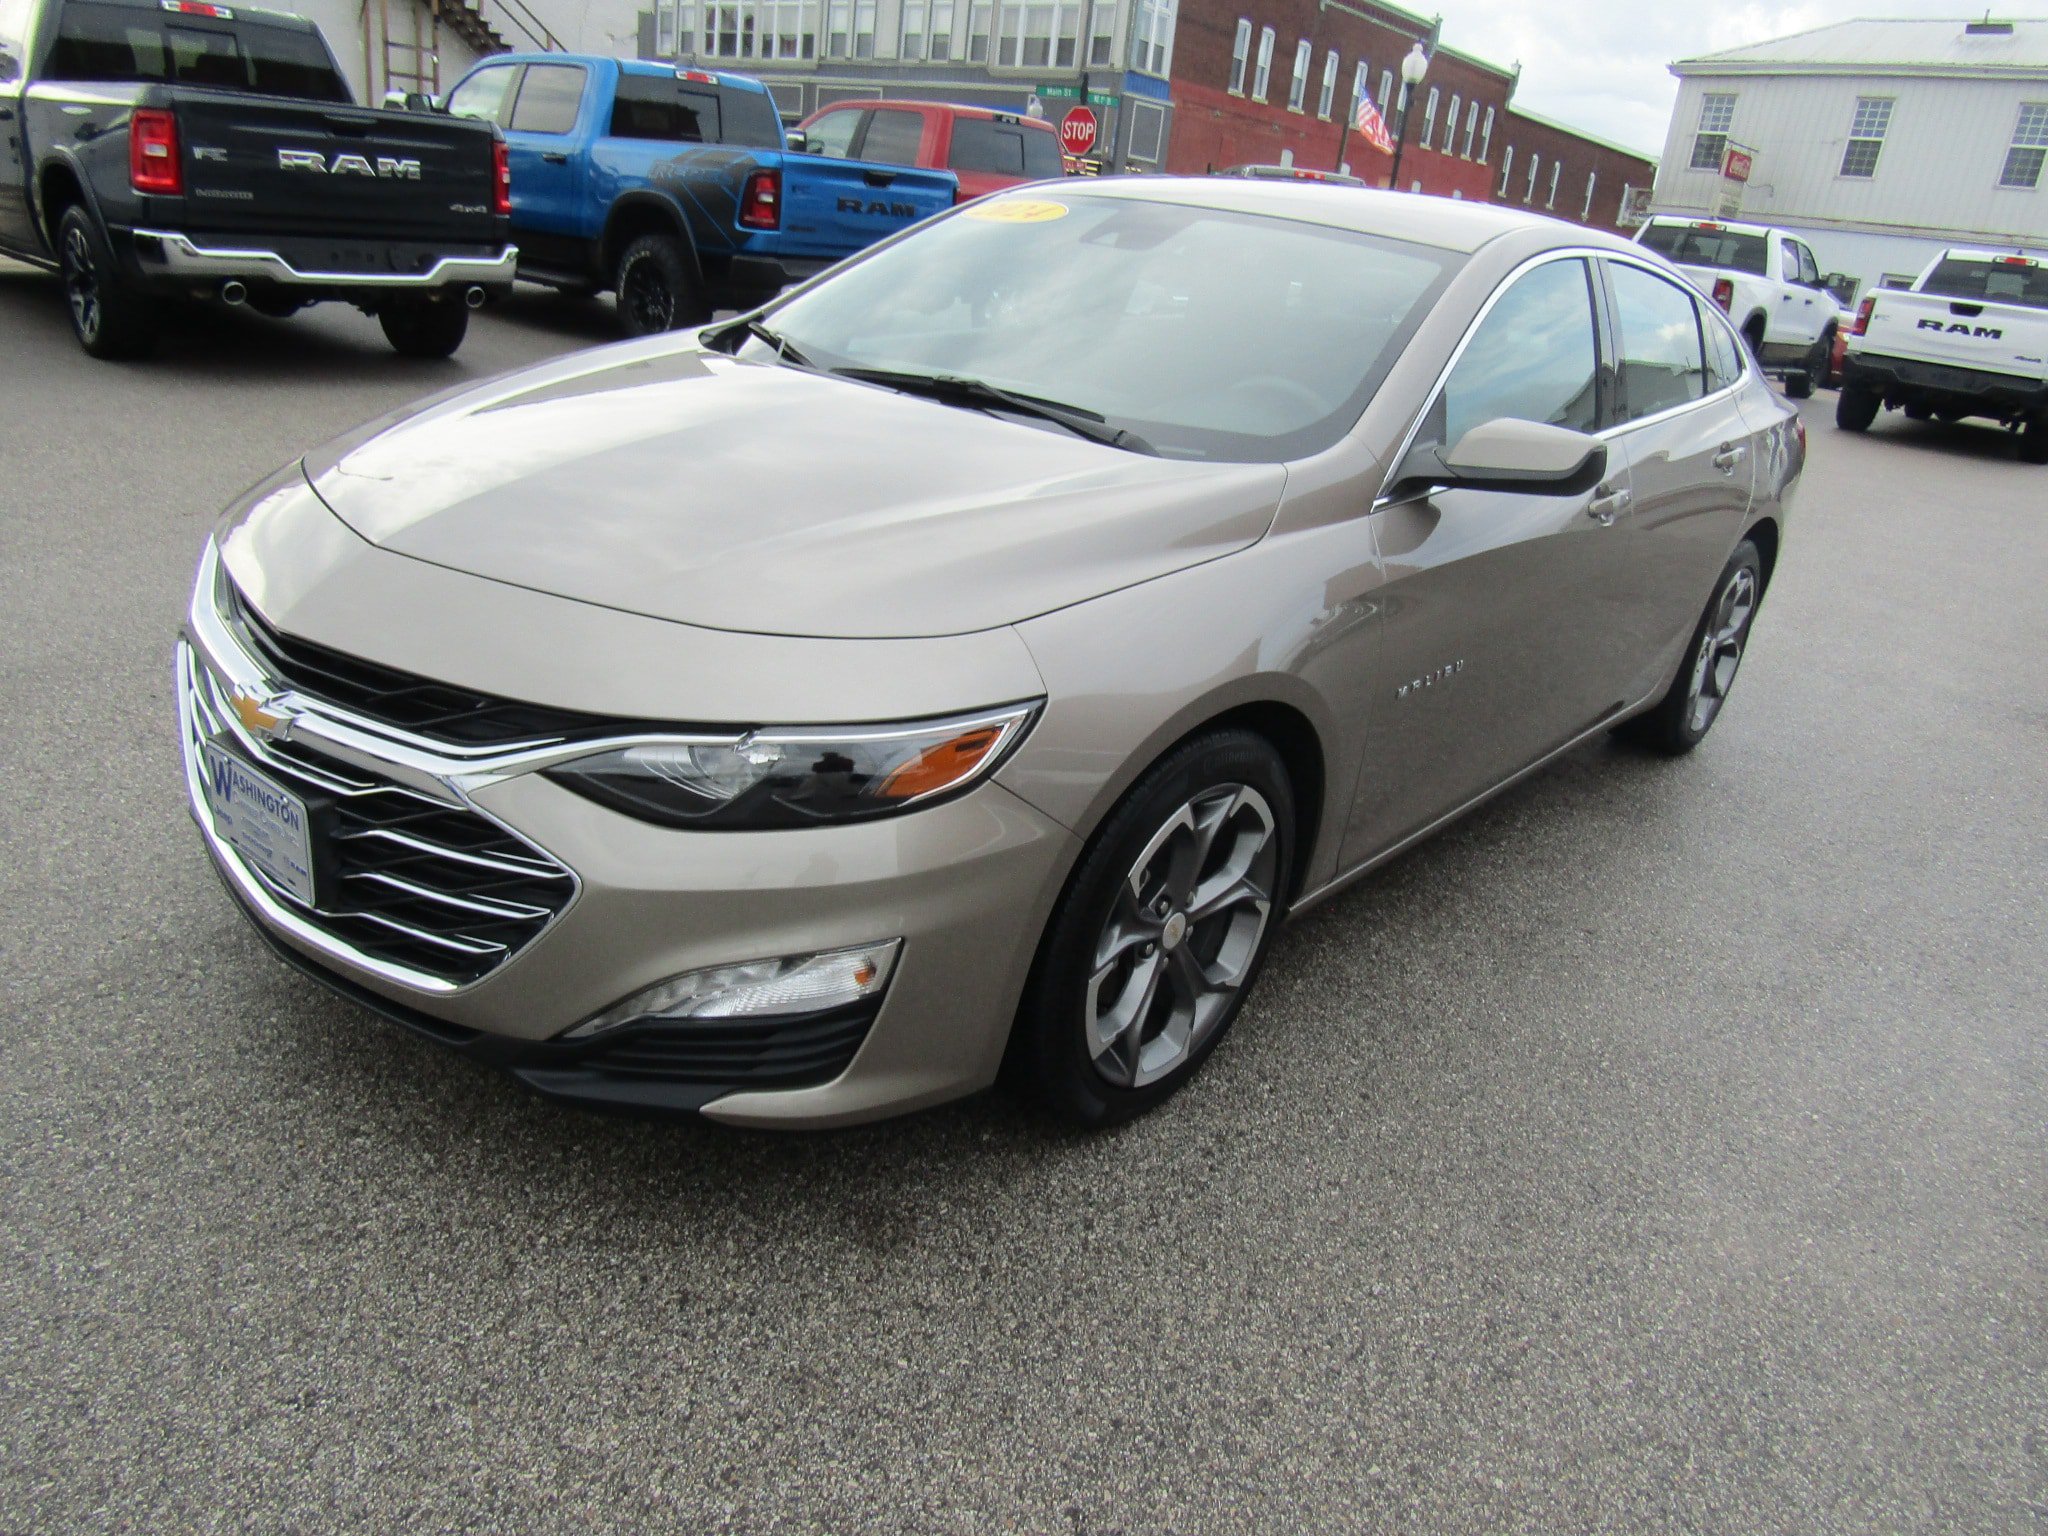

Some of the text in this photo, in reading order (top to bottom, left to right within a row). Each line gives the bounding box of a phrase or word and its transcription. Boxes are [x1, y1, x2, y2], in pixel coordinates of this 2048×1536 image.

[1046, 88, 1061, 96] Main
[1064, 121, 1094, 140] STOP
[277, 149, 422, 181] RAM
[836, 197, 916, 217] RAM
[1916, 319, 2002, 340] RAM
[209, 754, 300, 831] WASHINGTON
